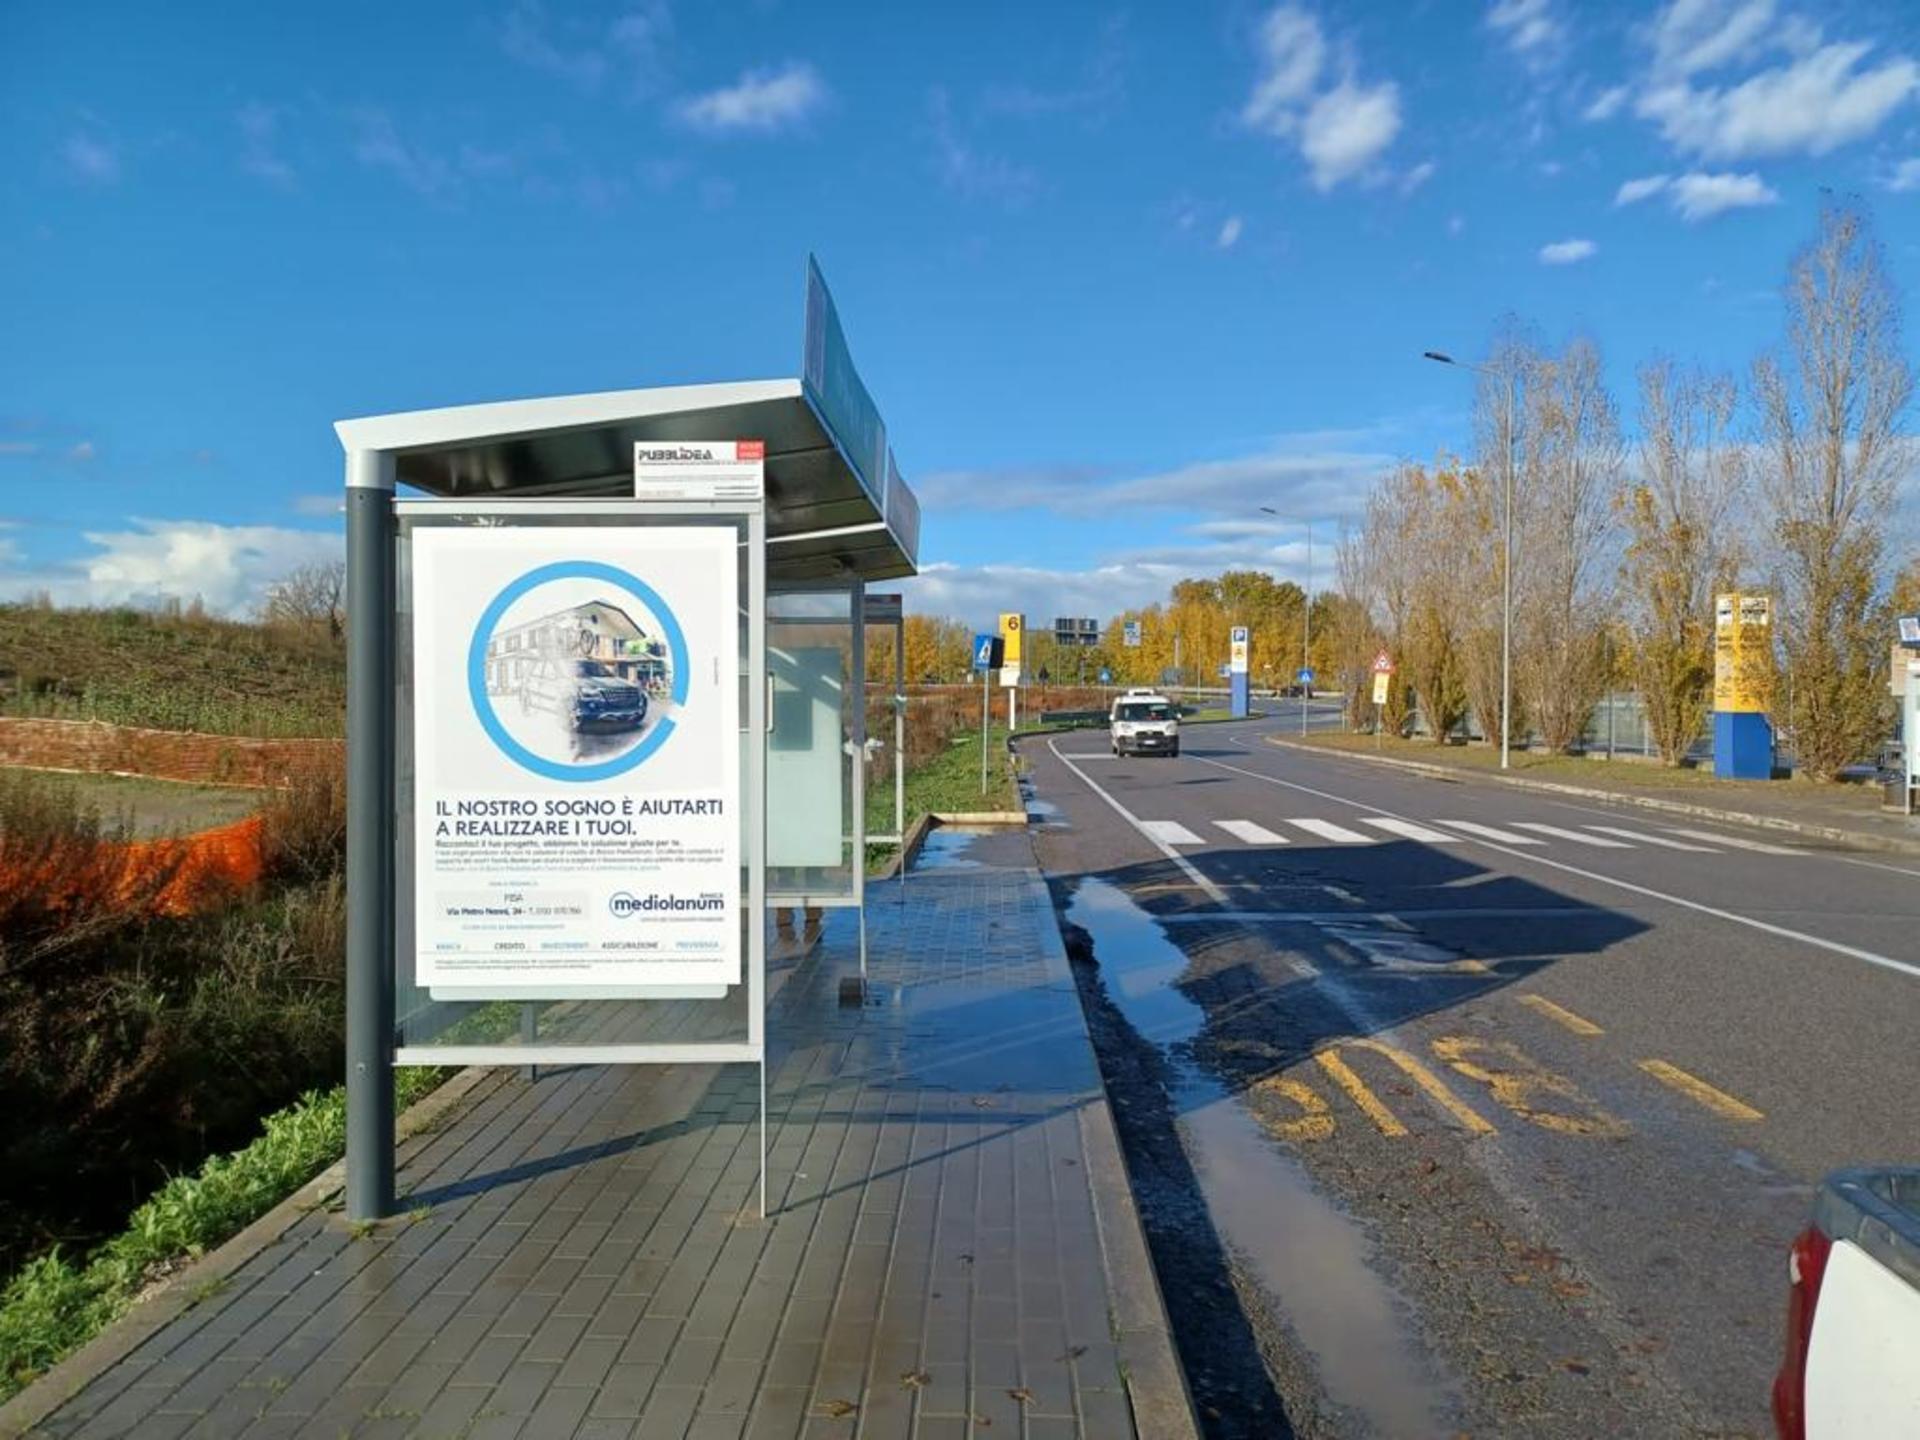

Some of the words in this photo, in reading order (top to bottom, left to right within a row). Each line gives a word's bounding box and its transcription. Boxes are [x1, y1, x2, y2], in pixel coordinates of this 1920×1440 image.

[1008, 616, 1018, 631] 6
[436, 800, 452, 816] IL
[458, 800, 538, 816] NOSTRO
[544, 800, 616, 816] SOGNO
[622, 795, 633, 815] È
[639, 799, 723, 815] AIUTARTI
[436, 820, 450, 836] A
[456, 820, 570, 836] REALIZZARE
[575, 820, 580, 836] I
[585, 820, 637, 836] TUOI.
[614, 894, 724, 910] mediolanum
[494, 942, 525, 950] CREDITO
